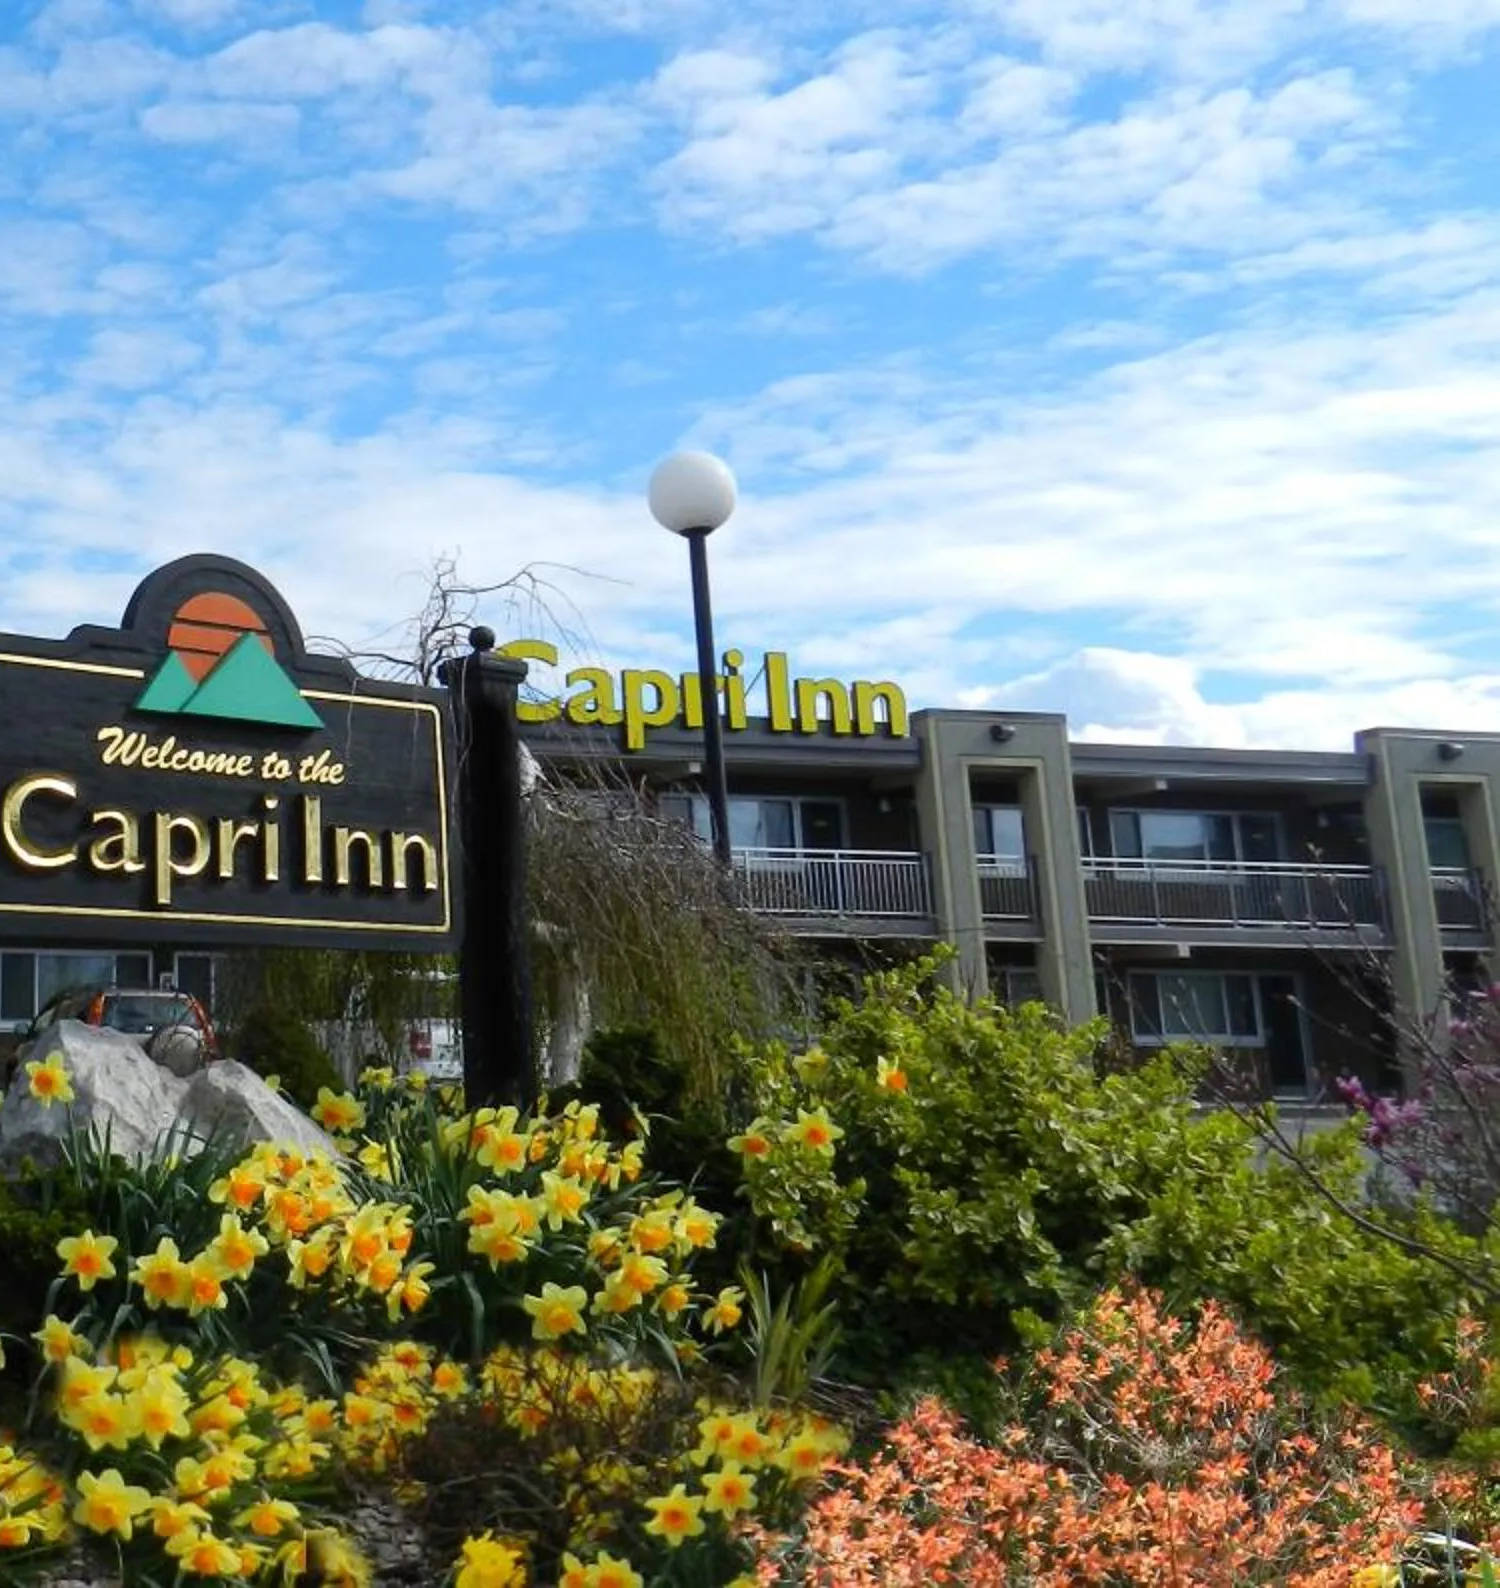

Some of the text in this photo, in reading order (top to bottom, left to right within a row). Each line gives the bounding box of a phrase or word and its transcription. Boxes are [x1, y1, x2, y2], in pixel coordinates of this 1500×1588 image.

[495, 639, 910, 750] Capri Inn
[97, 726, 345, 785] Welcome to the
[2, 776, 438, 905] Capri Inn
